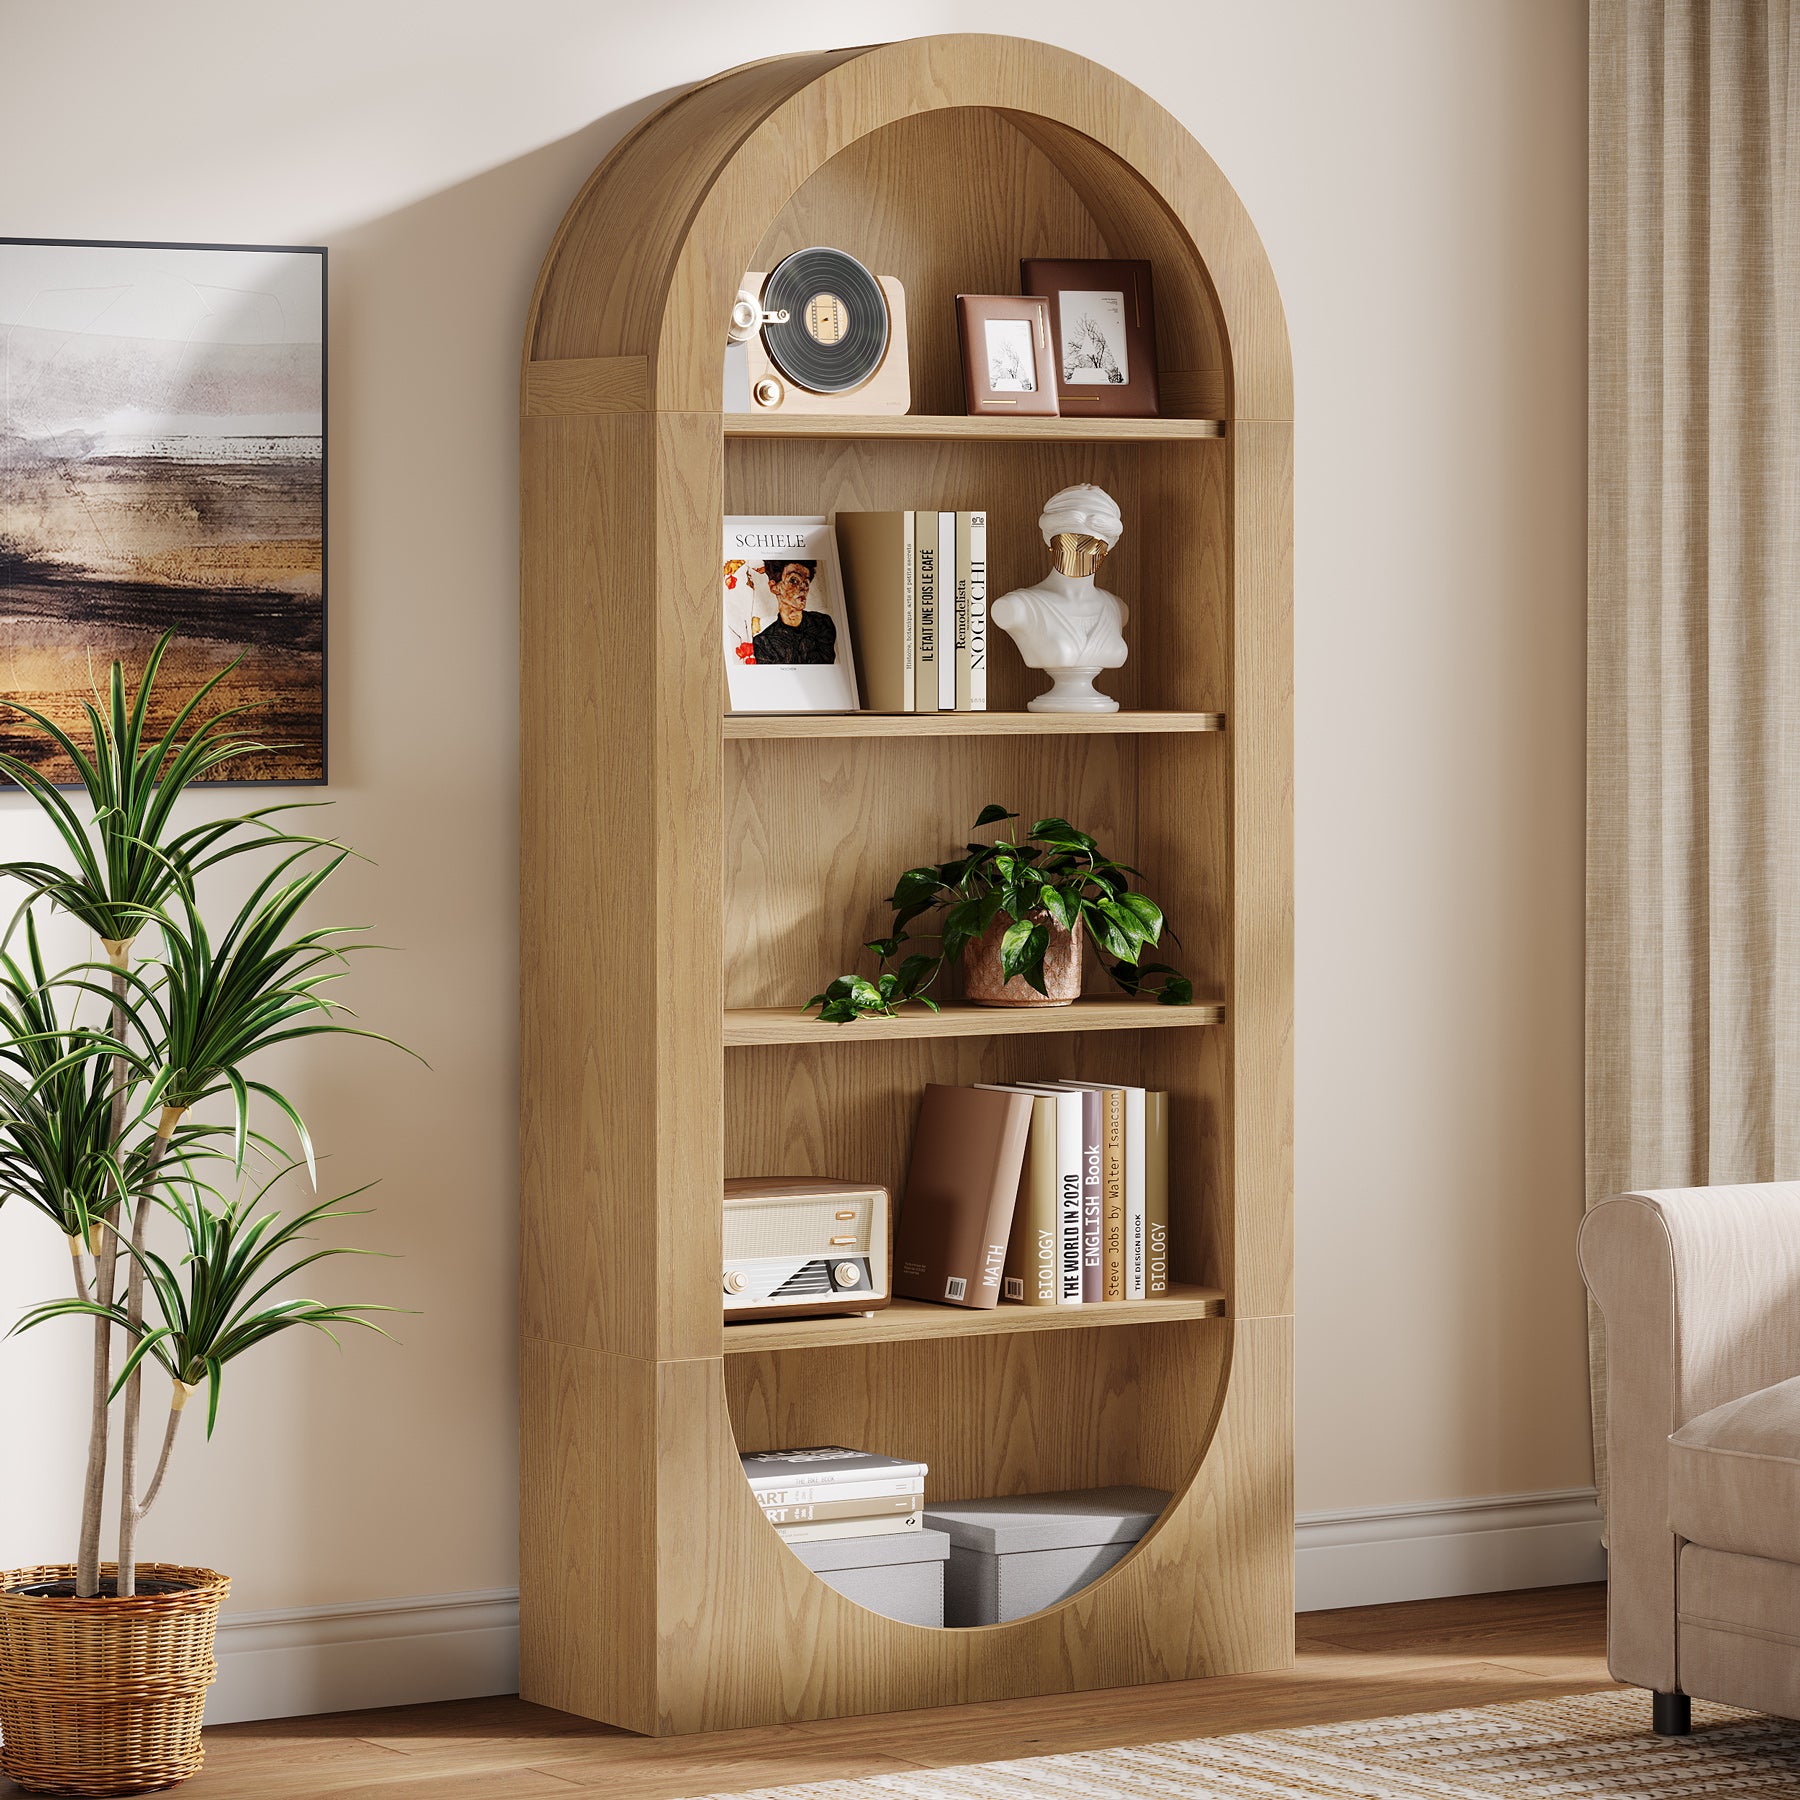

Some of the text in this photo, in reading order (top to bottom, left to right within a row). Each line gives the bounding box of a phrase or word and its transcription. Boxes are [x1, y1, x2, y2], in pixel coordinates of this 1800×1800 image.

[735, 533, 806, 549] SCHIELE
[920, 549, 933, 662] IL ÉTAIT UNE FOIS LE CAFÉ
[955, 580, 966, 650] Remodelista
[971, 561, 985, 670] NOGUCHI
[1084, 1144, 1100, 1268] ENGLISH Book
[1108, 1092, 1121, 1296] Steve Jobs by Walter Isaacson
[982, 1244, 1004, 1287] MATH
[1038, 1229, 1054, 1299] BIOLOGY
[1064, 1174, 1080, 1299] THE WORLD IN 2020
[1151, 1222, 1166, 1292] BIOLOGY
[756, 1491, 788, 1505] ART
